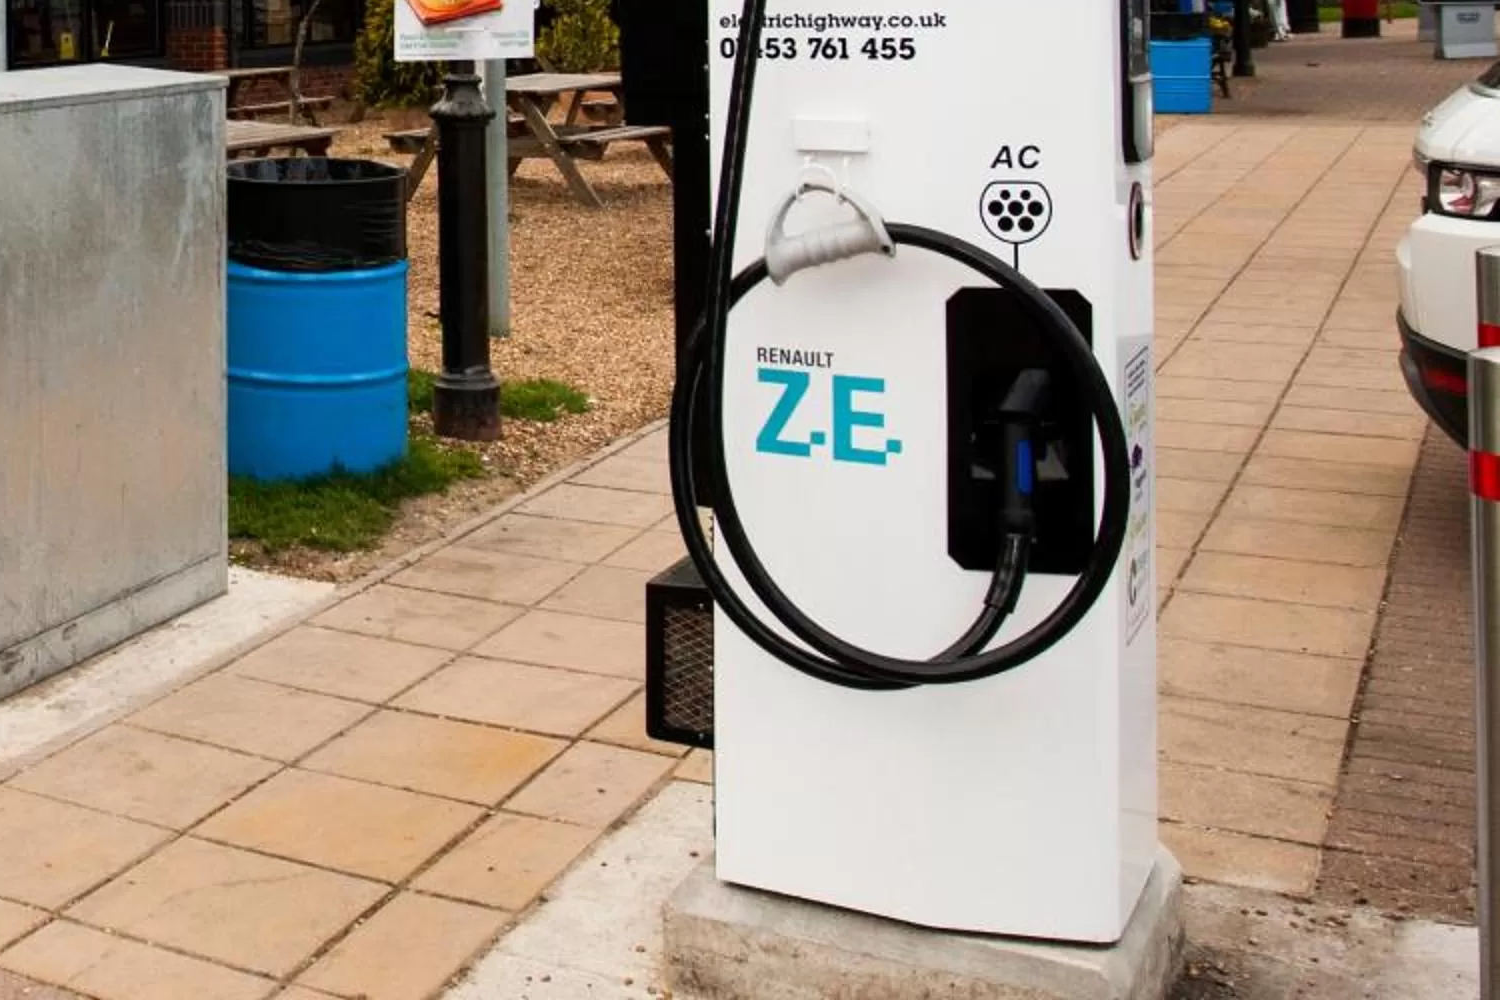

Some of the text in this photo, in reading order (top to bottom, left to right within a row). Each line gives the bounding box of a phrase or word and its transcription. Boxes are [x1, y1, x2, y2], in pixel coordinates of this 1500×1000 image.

[719, 12, 947, 32] elrichighway.co.uk
[720, 37, 916, 60] 053 761 455
[990, 145, 1041, 169] AC
[757, 347, 835, 369] RENAULT
[756, 367, 903, 466] Z.E.
